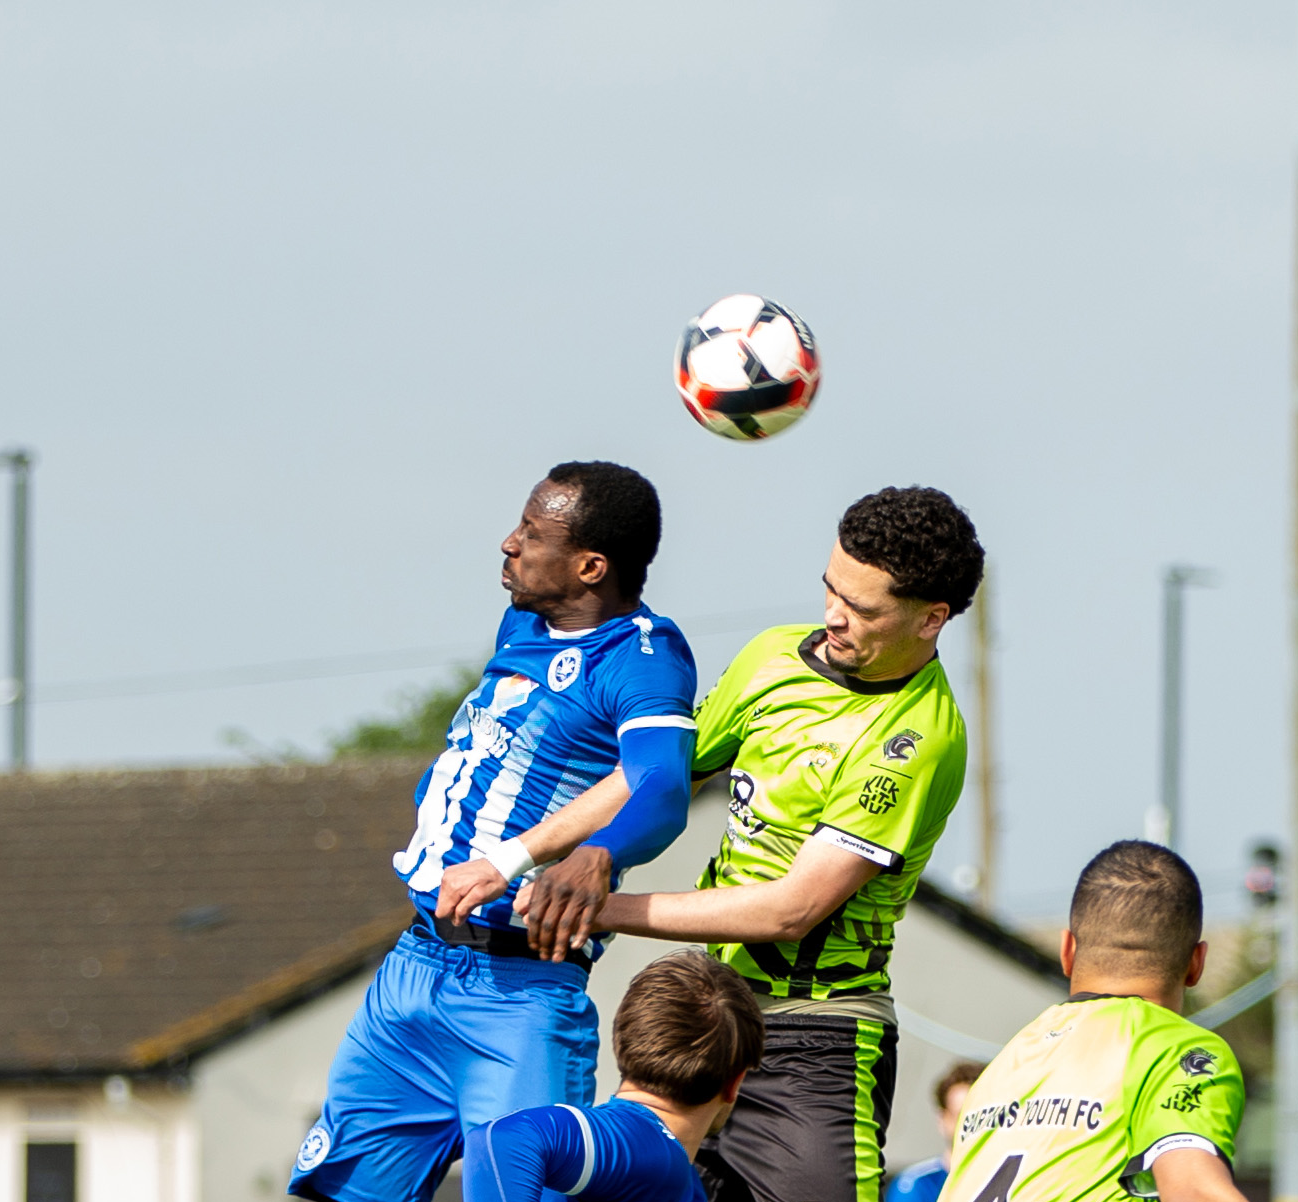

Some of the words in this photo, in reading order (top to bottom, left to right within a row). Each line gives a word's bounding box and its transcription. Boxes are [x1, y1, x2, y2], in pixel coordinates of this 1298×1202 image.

[863, 776, 899, 803] KICK
[859, 794, 896, 814] OUT
[1021, 1098, 1072, 1126] YOUTH
[1073, 1099, 1103, 1130] FC
